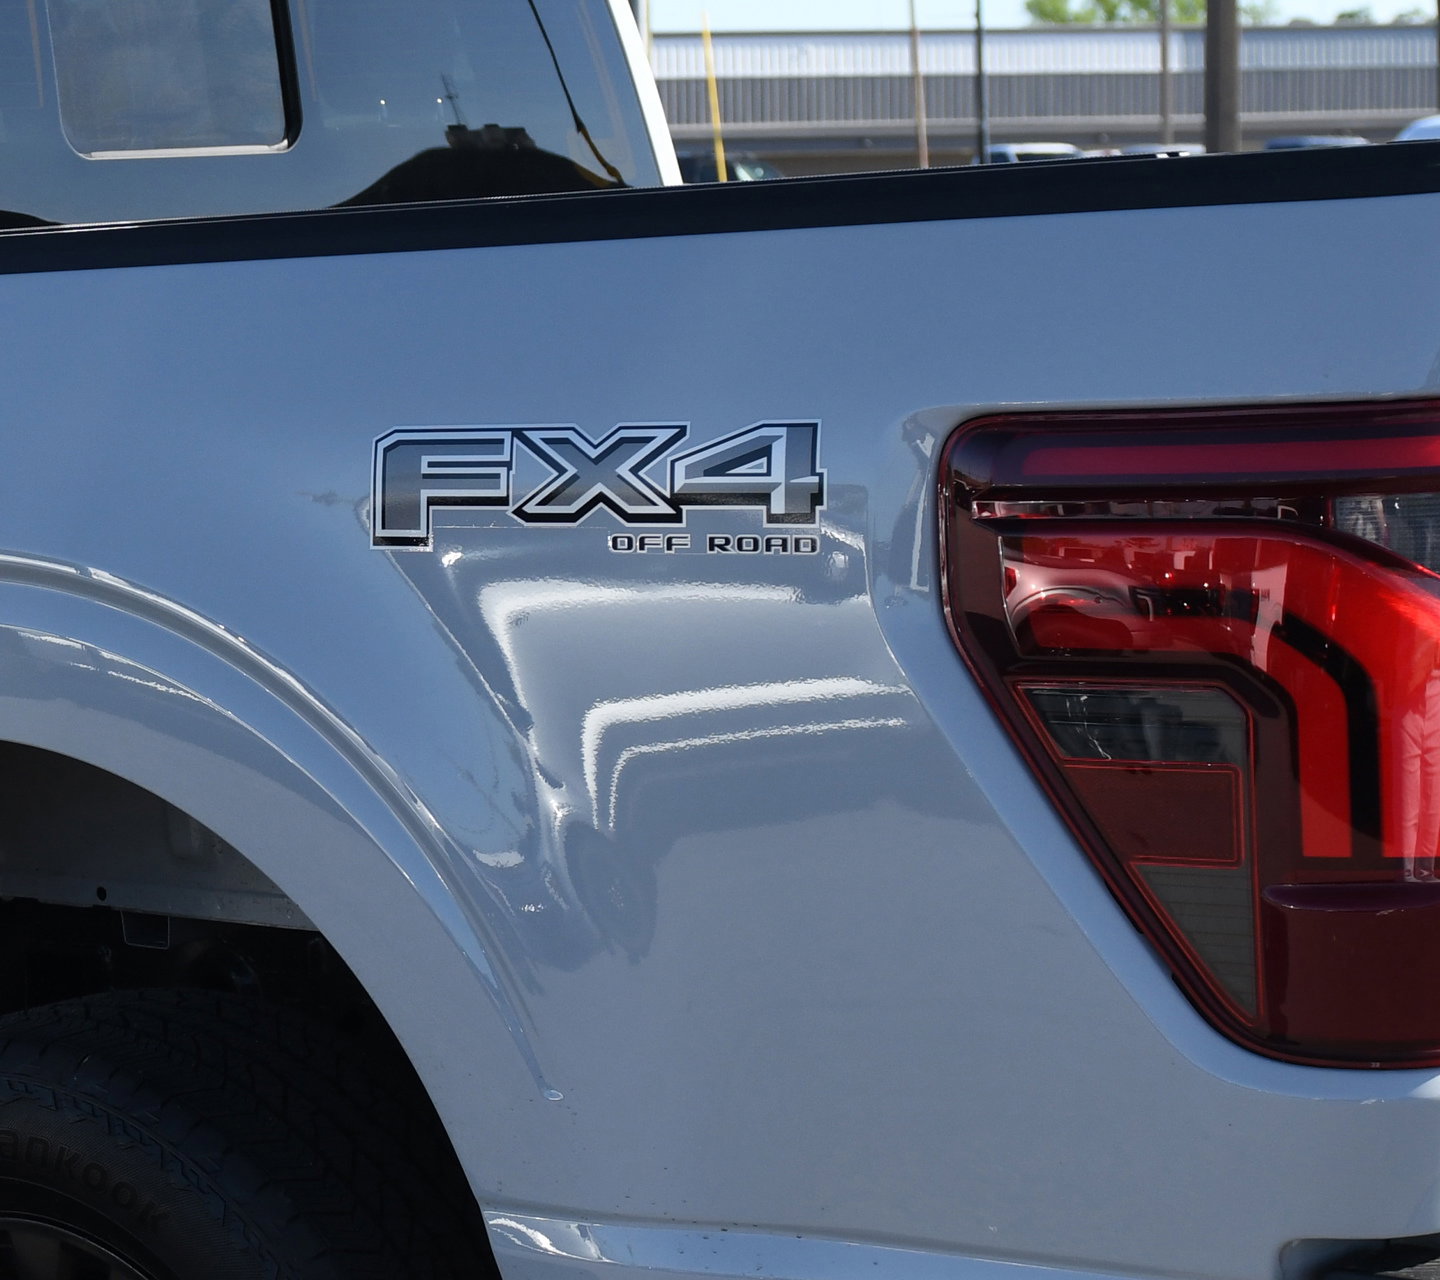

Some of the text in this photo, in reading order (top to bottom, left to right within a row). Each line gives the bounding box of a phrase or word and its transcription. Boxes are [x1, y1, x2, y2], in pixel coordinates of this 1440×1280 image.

[370, 418, 827, 551] FX4
[610, 533, 820, 555] OFF ROAD
